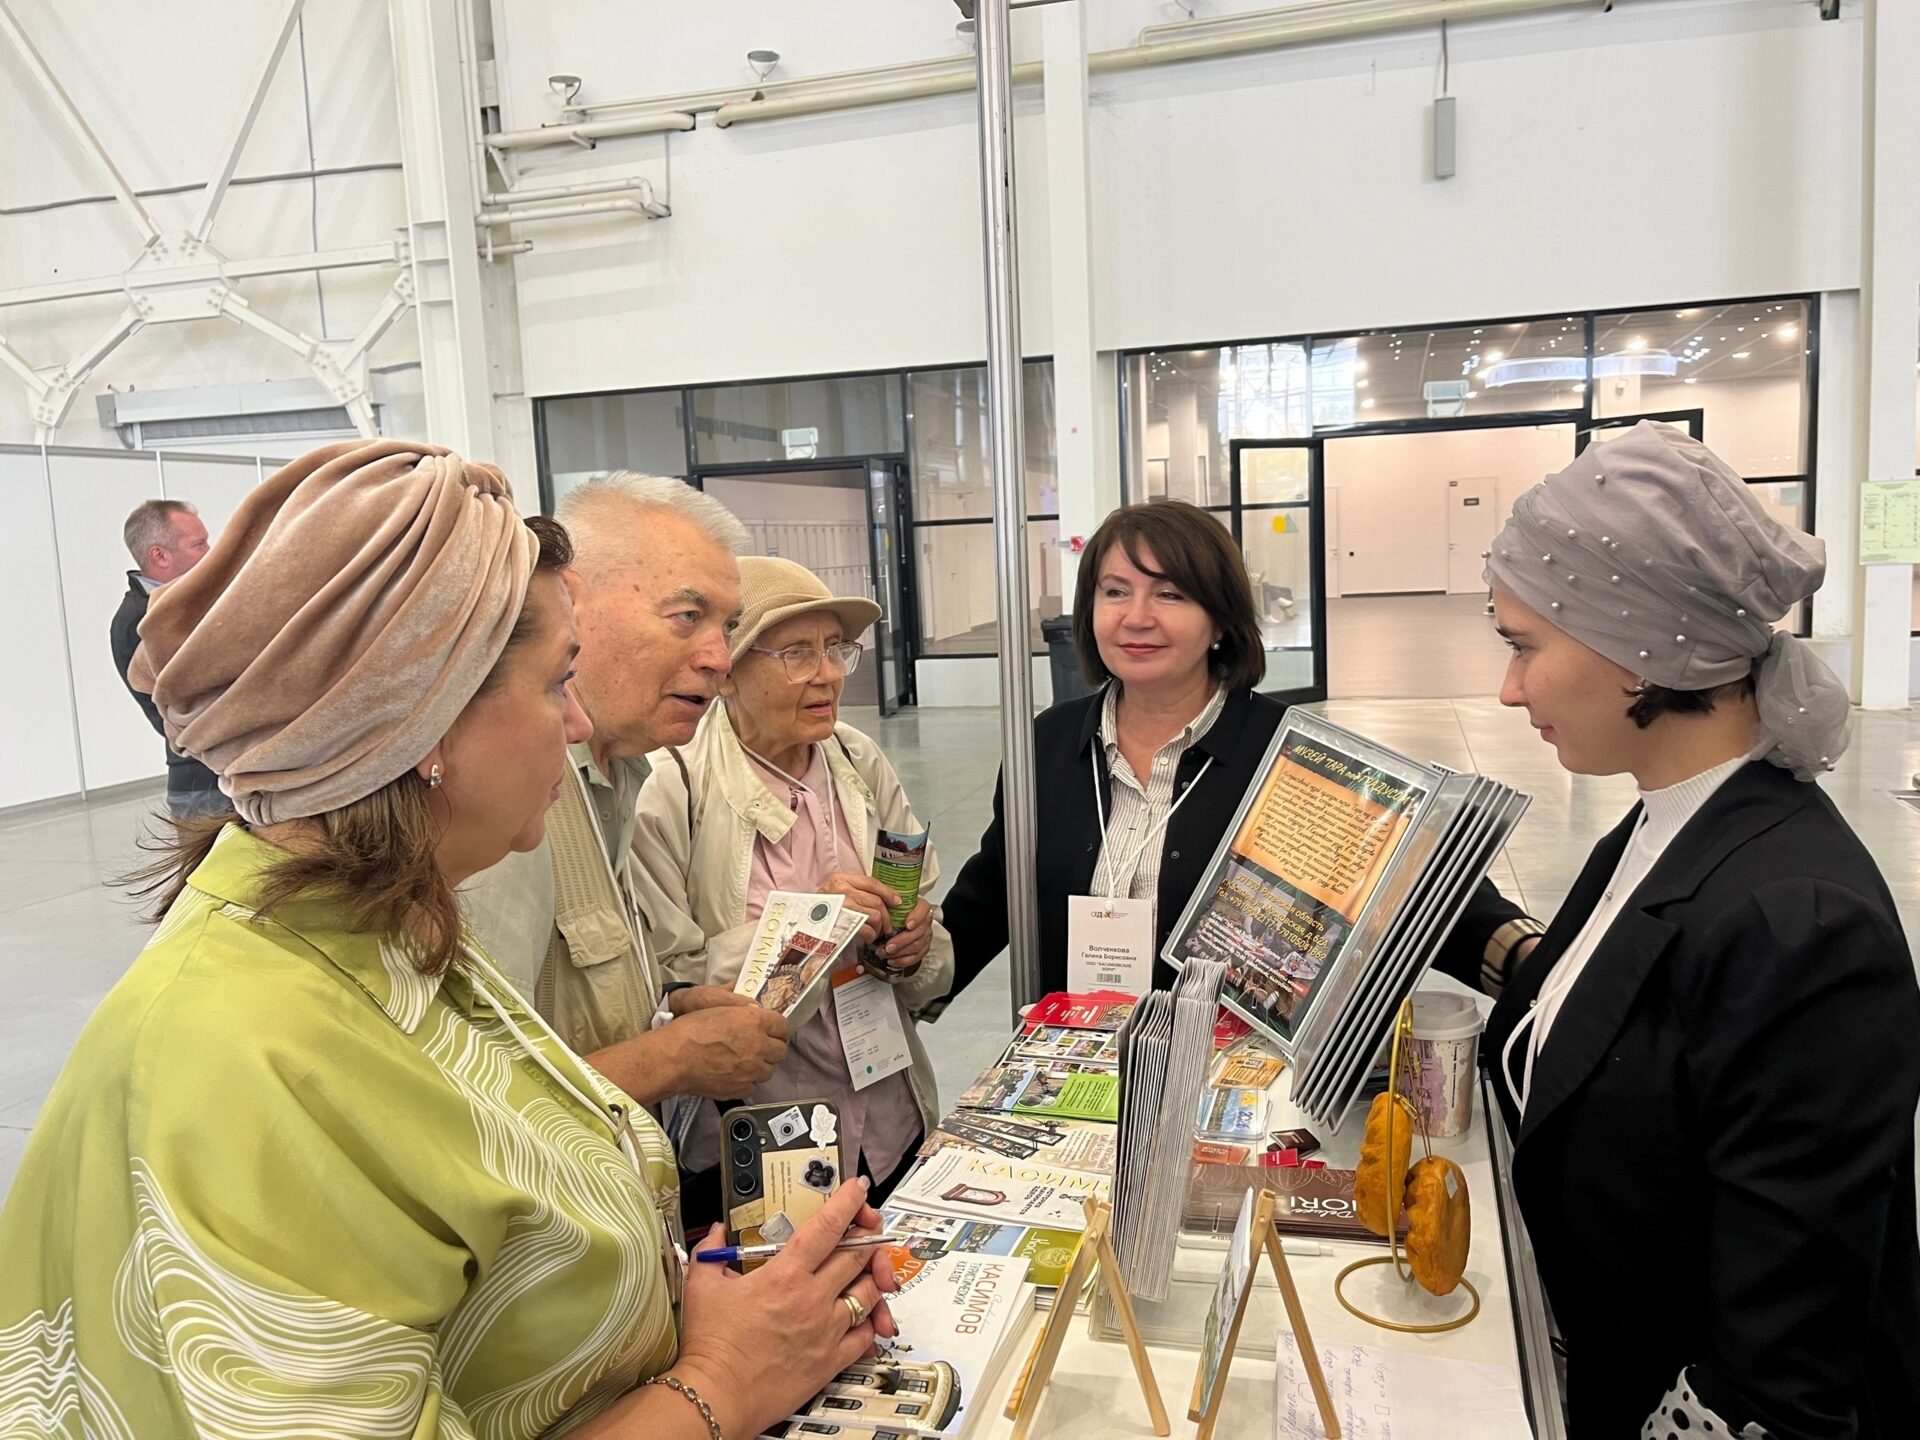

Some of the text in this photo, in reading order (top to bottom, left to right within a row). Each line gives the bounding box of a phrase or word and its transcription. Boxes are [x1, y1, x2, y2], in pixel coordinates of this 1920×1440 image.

[1292, 741, 1325, 765] МУЗЕЙ
[1259, 886, 1295, 913] Рязанская
[1295, 908, 1325, 931] область
[1089, 944, 1130, 953] Волченкова
[1103, 953, 1137, 961] Борисовна
[1290, 1196, 1357, 1211] IORI
[1291, 1208, 1357, 1219] Deluxe
[948, 1261, 967, 1285] КАТАЛОГ
[953, 1262, 982, 1305] ТУРИСТИЧЕСКИЙ
[955, 1263, 1005, 1335] КАСИМОВ
